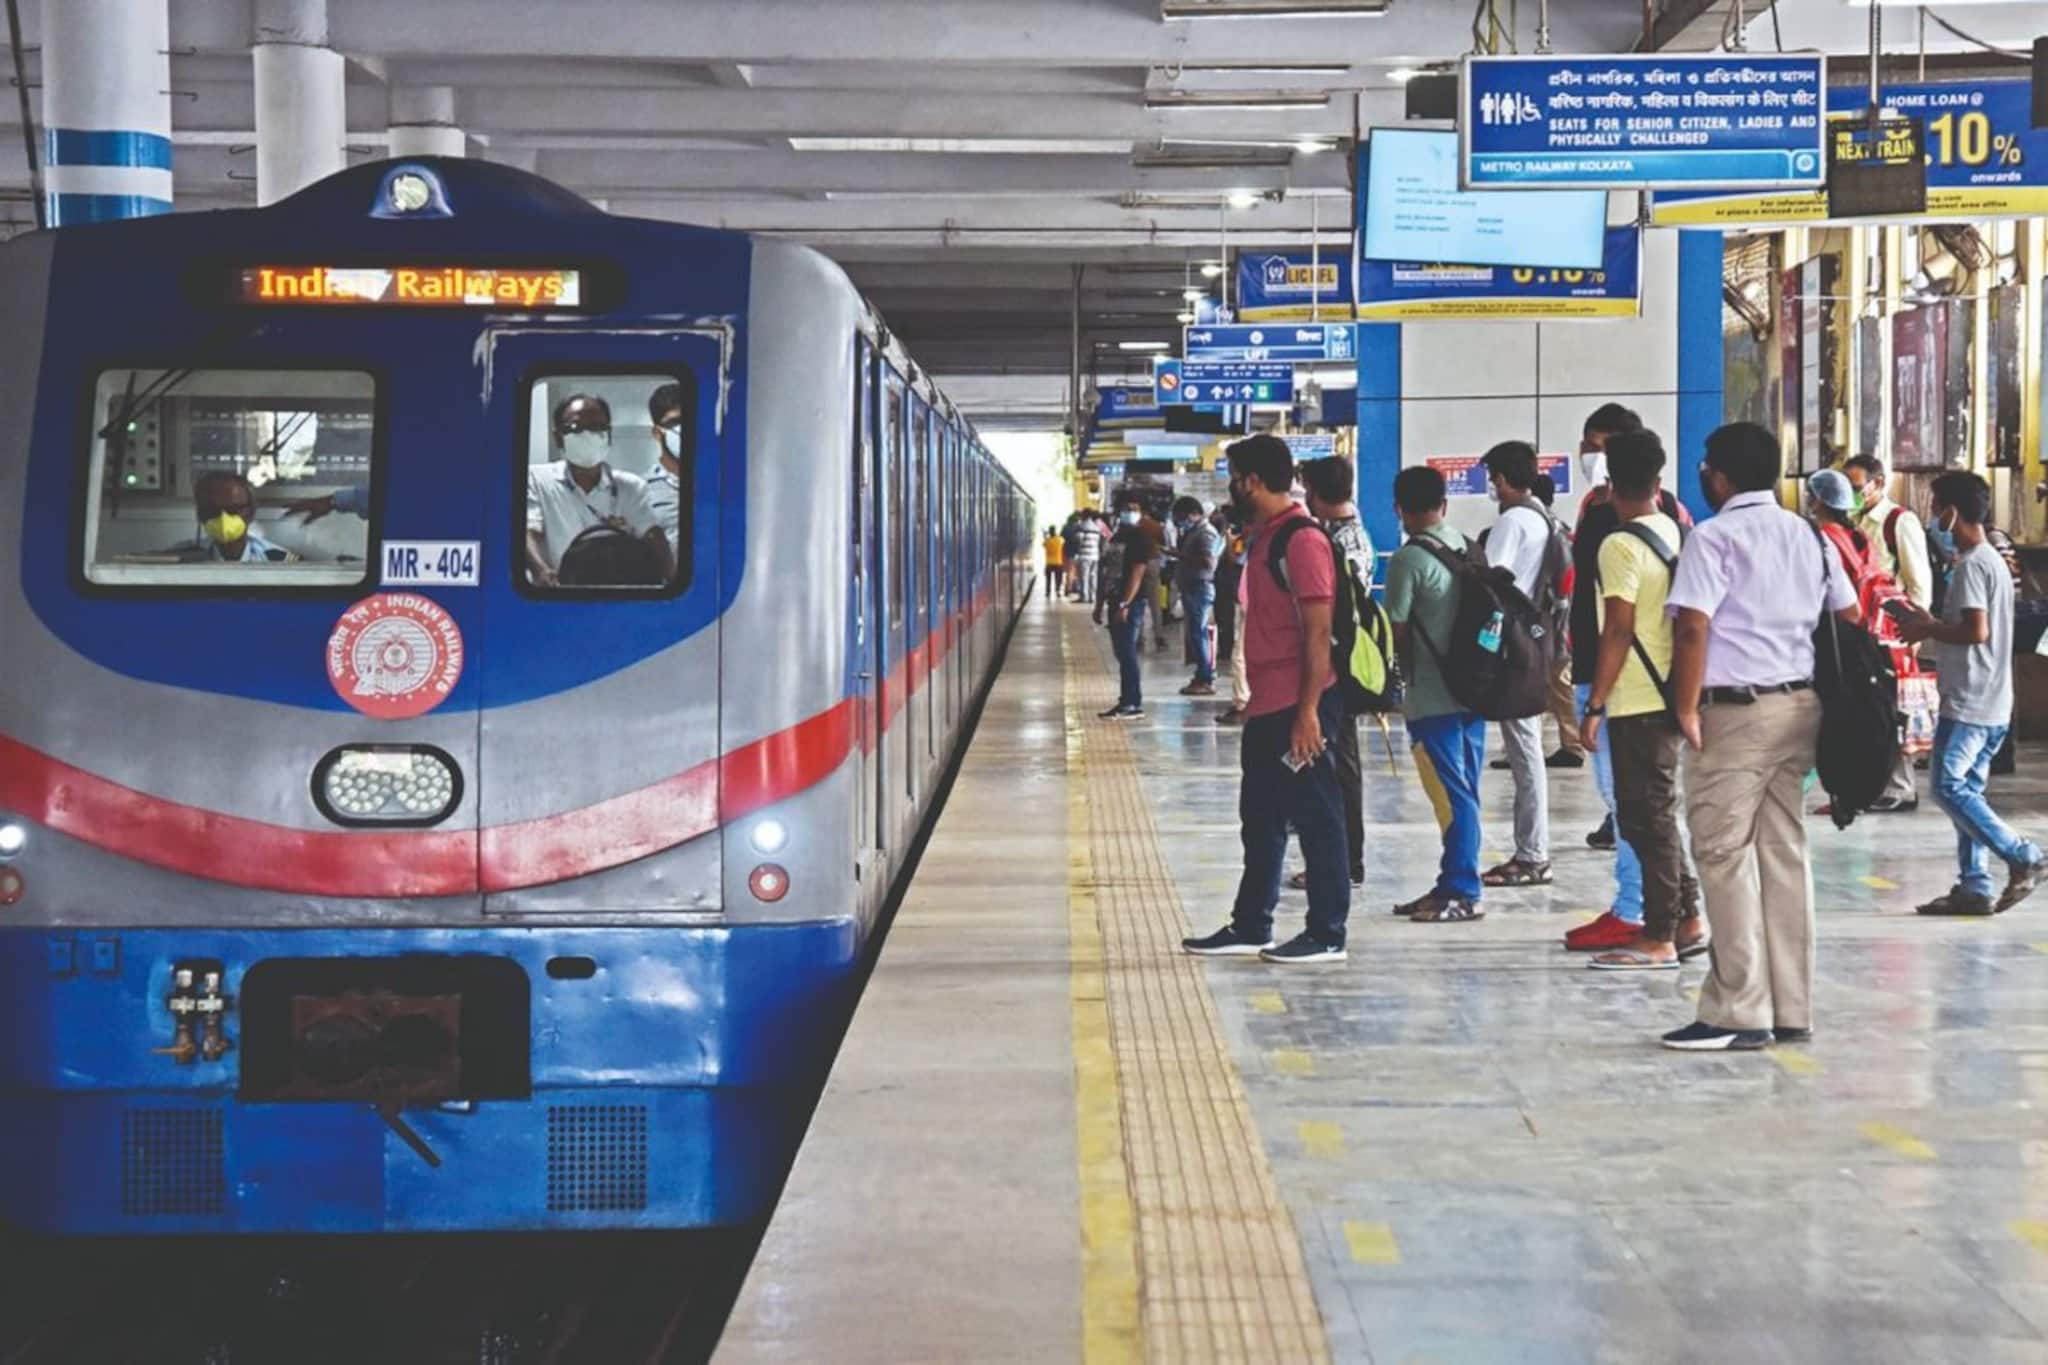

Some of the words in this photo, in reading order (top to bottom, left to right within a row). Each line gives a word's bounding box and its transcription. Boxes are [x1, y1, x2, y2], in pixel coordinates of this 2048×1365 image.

[1687, 72, 1699, 84] ও
[1641, 91, 1679, 108] महिला
[1791, 88, 1817, 105] सीट
[1886, 95, 1926, 107] HOME
[1930, 93, 1969, 106] LOAN
[1549, 118, 1588, 131] SEATS
[1594, 117, 1620, 131] FOR
[1627, 117, 1674, 130] SENIOR
[1680, 116, 1732, 130] CITIZEN,
[1739, 115, 1784, 128] LADIES
[1790, 115, 1817, 128] AND
[1549, 133, 1621, 145] PHYSICALLY
[1630, 132, 1709, 145] CHALLENGED
[1480, 161, 1522, 172] METRO
[1525, 160, 1577, 172] RAILWAY
[1579, 160, 1634, 171] KOLKATA
[1970, 171, 2022, 184] onwards
[397, 268, 563, 306] Railways
[387, 549, 418, 578] MR
[437, 549, 473, 578] 404
[388, 595, 441, 621] INDIAN
[437, 620, 463, 693] RAILWAYS
